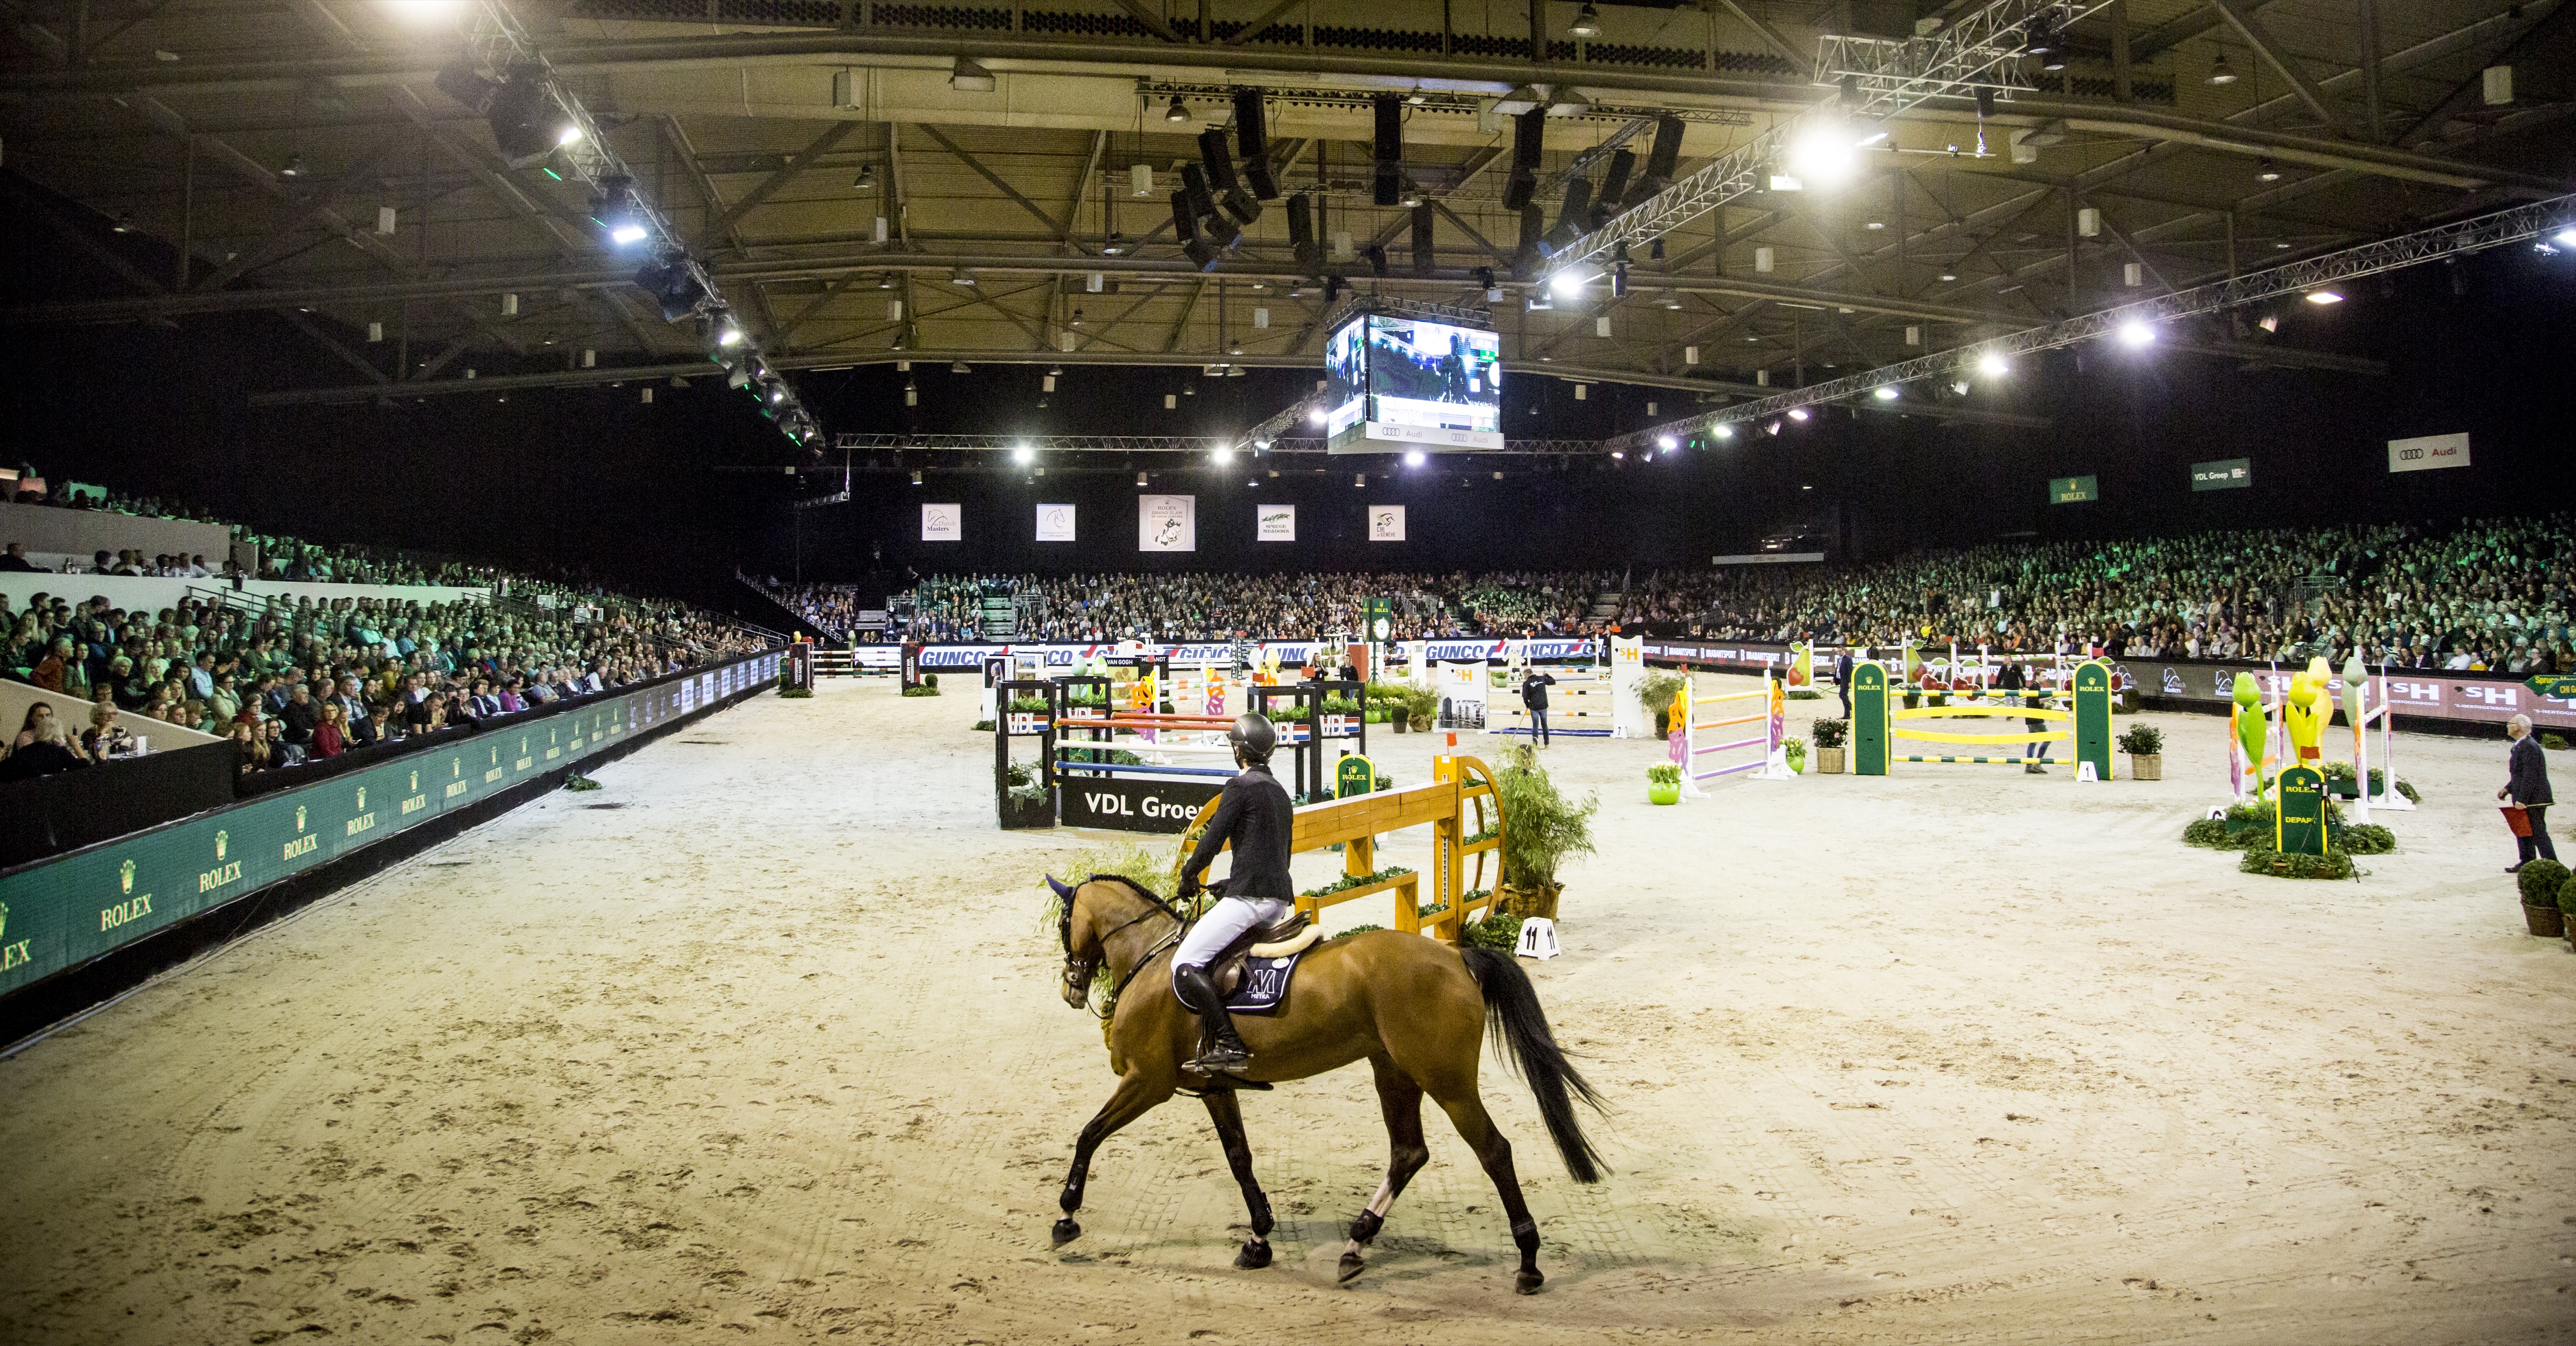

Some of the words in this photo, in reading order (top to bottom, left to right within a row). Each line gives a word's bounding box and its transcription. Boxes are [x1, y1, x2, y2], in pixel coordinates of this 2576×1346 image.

[2432, 447, 2457, 456] Audi
[2061, 491, 2087, 501] ROLEX
[922, 651, 986, 666] GUNCO
[1426, 645, 1484, 659] GUNCO
[1669, 647, 1697, 657] BRABANTSPORT
[1706, 649, 1736, 659] BRABANTSPORT
[1746, 651, 1780, 662] BRABANTSPORT
[1006, 712, 1038, 734] VDL
[1319, 714, 1350, 737] VDL
[1618, 726, 1621, 736] 7
[485, 766, 502, 783] ROLEX
[2086, 765, 2089, 778] 1
[446, 779, 467, 798] ROLEX
[402, 794, 426, 815] ROLEX
[1084, 792, 1133, 815] VDL
[1142, 796, 1206, 820] Groe
[347, 812, 375, 837] ROLEX
[284, 833, 317, 861] ROLEX
[199, 861, 242, 893] ROLEX
[101, 894, 152, 932] ROLEX
[1526, 926, 1537, 950] 11
[1547, 925, 1555, 950] 11
